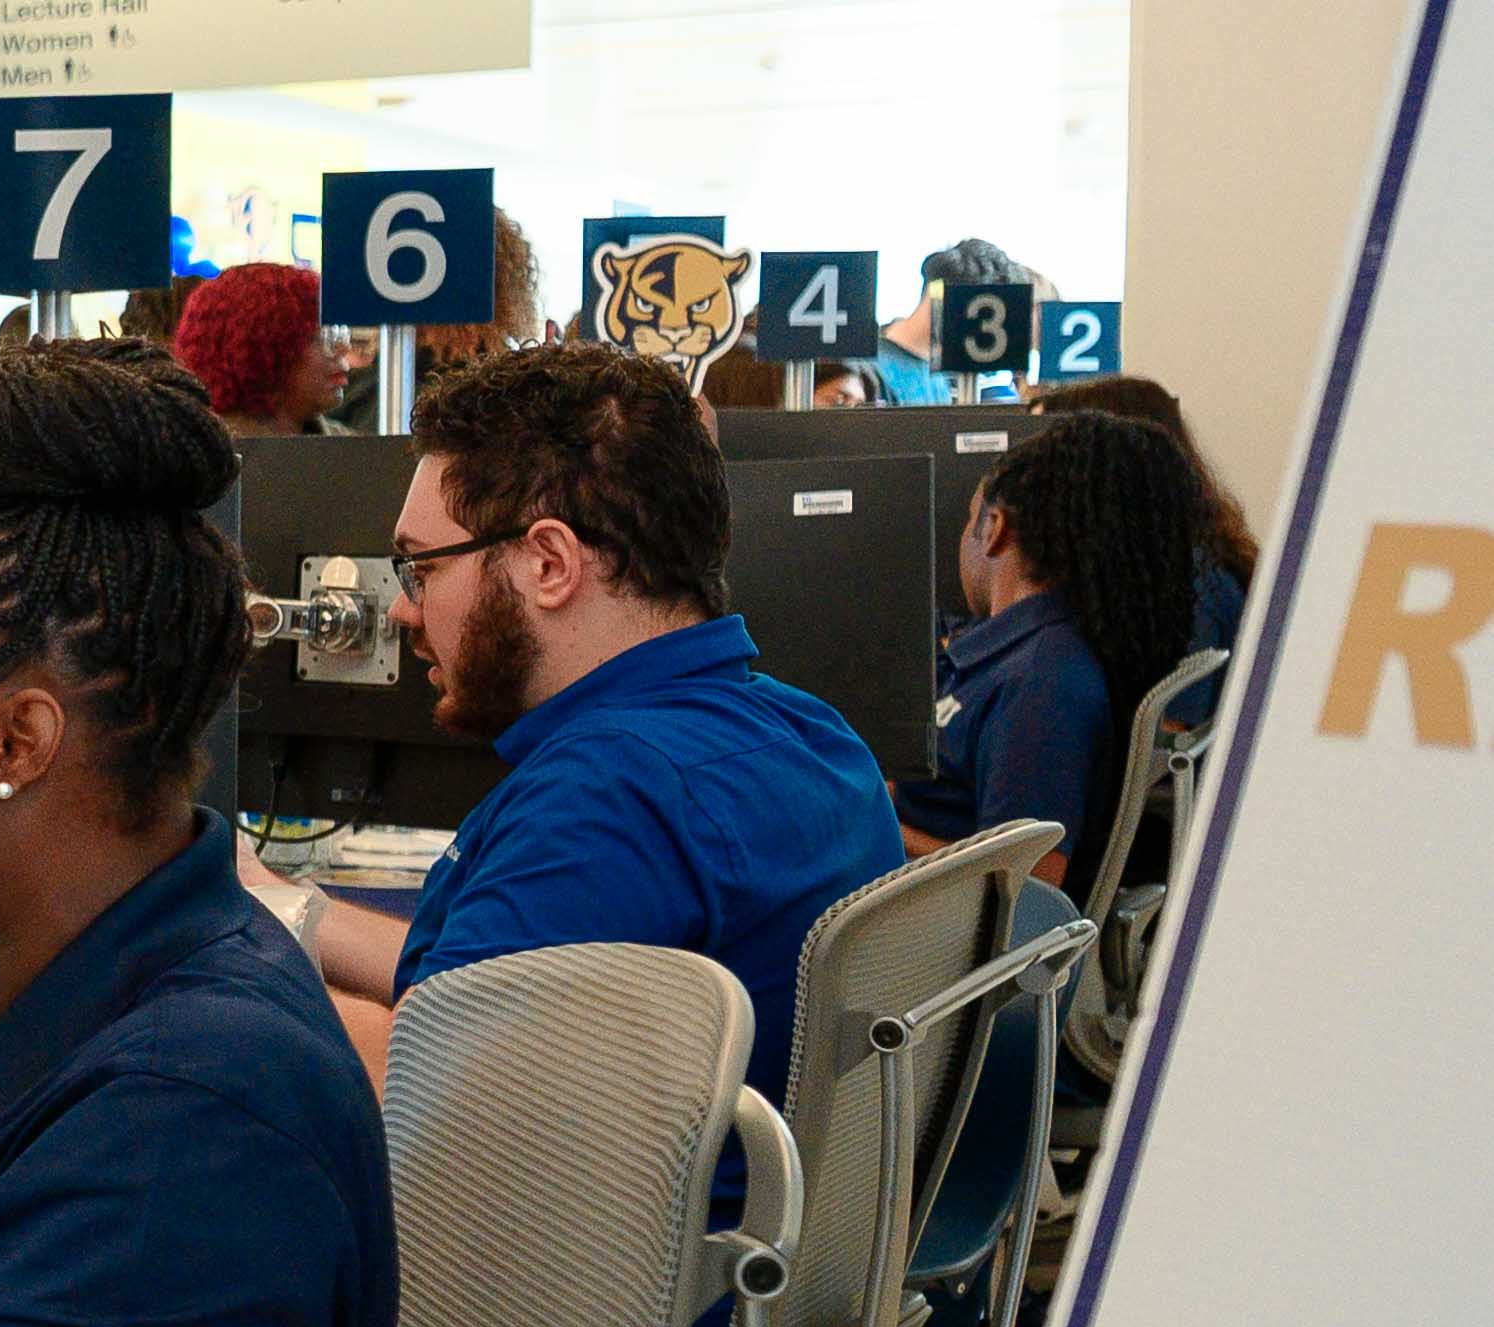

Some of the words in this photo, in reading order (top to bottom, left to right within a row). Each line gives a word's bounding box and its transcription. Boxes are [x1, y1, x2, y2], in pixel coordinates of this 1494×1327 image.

[1, 0, 93, 24] Lecture
[1, 30, 93, 54] Women
[1, 65, 53, 87] Men
[13, 126, 114, 261] 7
[365, 190, 447, 304] 6
[787, 264, 849, 346] 4
[964, 293, 1009, 363] 3
[1059, 309, 1102, 373] 2
[1317, 522, 1494, 752] R
